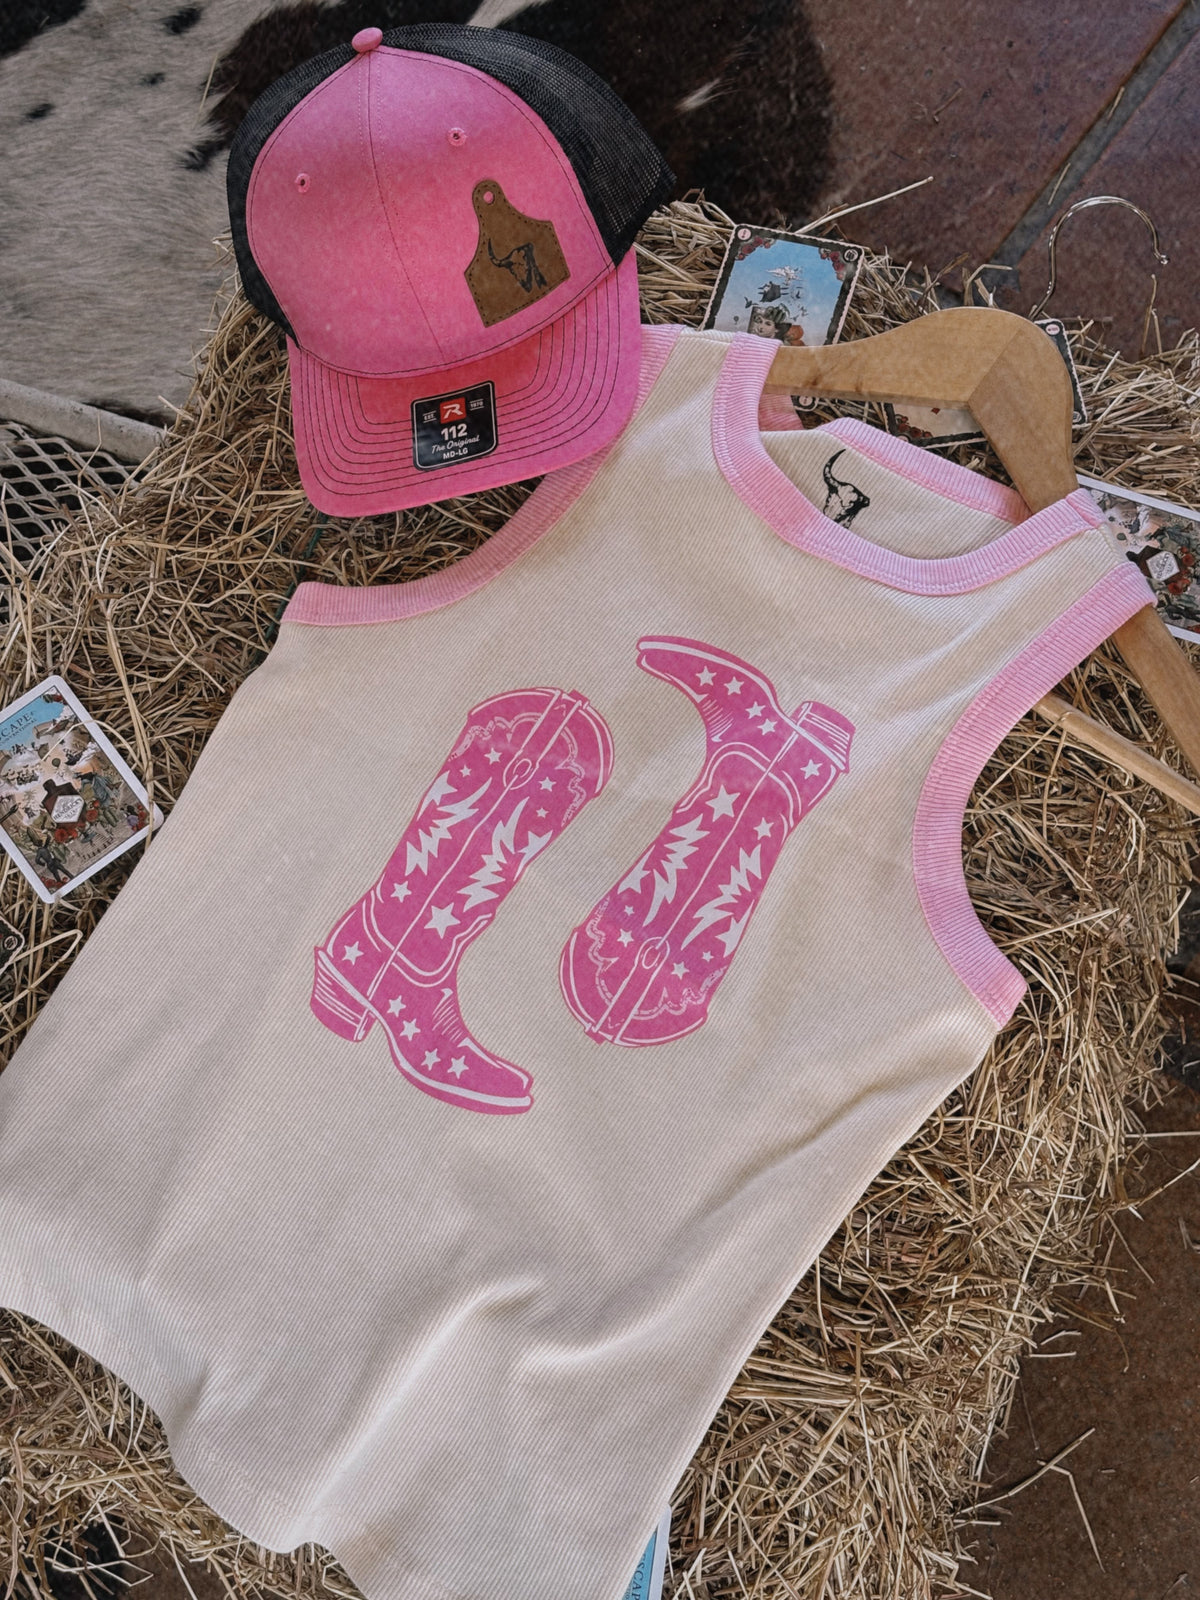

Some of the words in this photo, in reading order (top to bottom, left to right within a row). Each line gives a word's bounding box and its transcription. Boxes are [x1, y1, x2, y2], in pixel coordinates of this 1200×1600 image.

[441, 423, 468, 440] 112
[432, 444, 446, 454] The
[446, 435, 480, 450] Original
[443, 447, 468, 460] MD-LG
